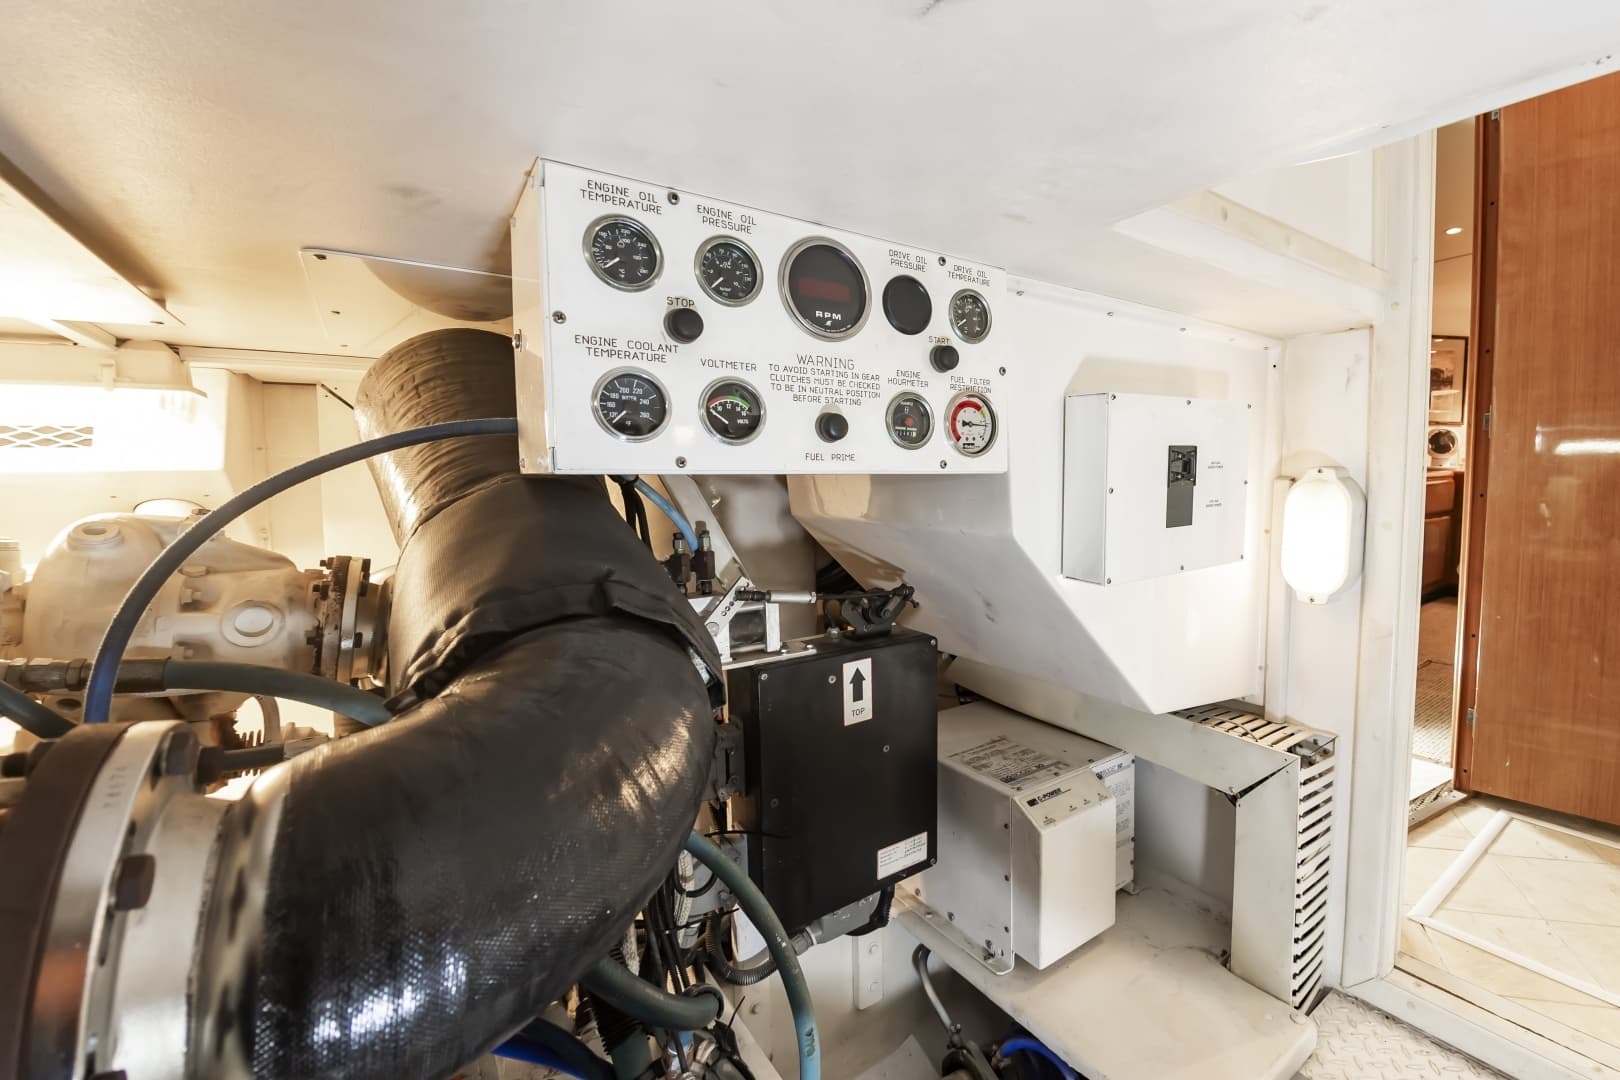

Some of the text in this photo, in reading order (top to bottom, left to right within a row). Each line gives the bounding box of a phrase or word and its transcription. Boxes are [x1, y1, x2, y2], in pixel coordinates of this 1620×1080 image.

[587, 179, 658, 204] ENGINE OIL
[580, 188, 662, 216] TEMPERATURE
[696, 204, 758, 226] ENGINE OIL
[702, 216, 752, 234] PRESSURE
[889, 249, 928, 265] DRIVE OIL
[890, 258, 926, 272] PRESSURE
[954, 264, 988, 278] DRIVE OIL
[948, 271, 990, 288] TEMPERATURE
[666, 296, 696, 308] STOP
[816, 310, 842, 320] RPM
[574, 334, 679, 354] ENGINE COOLANT
[928, 336, 950, 345] START
[585, 346, 668, 364] TEMPERATURE
[796, 354, 855, 370] WARNING
[700, 358, 758, 372] VOLTMETER
[768, 364, 880, 382] TO AVOID STARTING IN GEAR
[896, 370, 921, 379] ENGINE
[770, 374, 880, 390] CLUTCHES MUST BE CHECKED
[888, 378, 929, 388] HOURMETER
[950, 376, 990, 386] FUEL FILTER
[770, 382, 880, 398] TO BE IN NEUTRAL POSITION
[950, 384, 992, 394] RESTRICTION
[792, 394, 862, 406] BEFORE STARTING
[805, 453, 856, 462] FUEL PRIME
[852, 708, 865, 717] TOP
